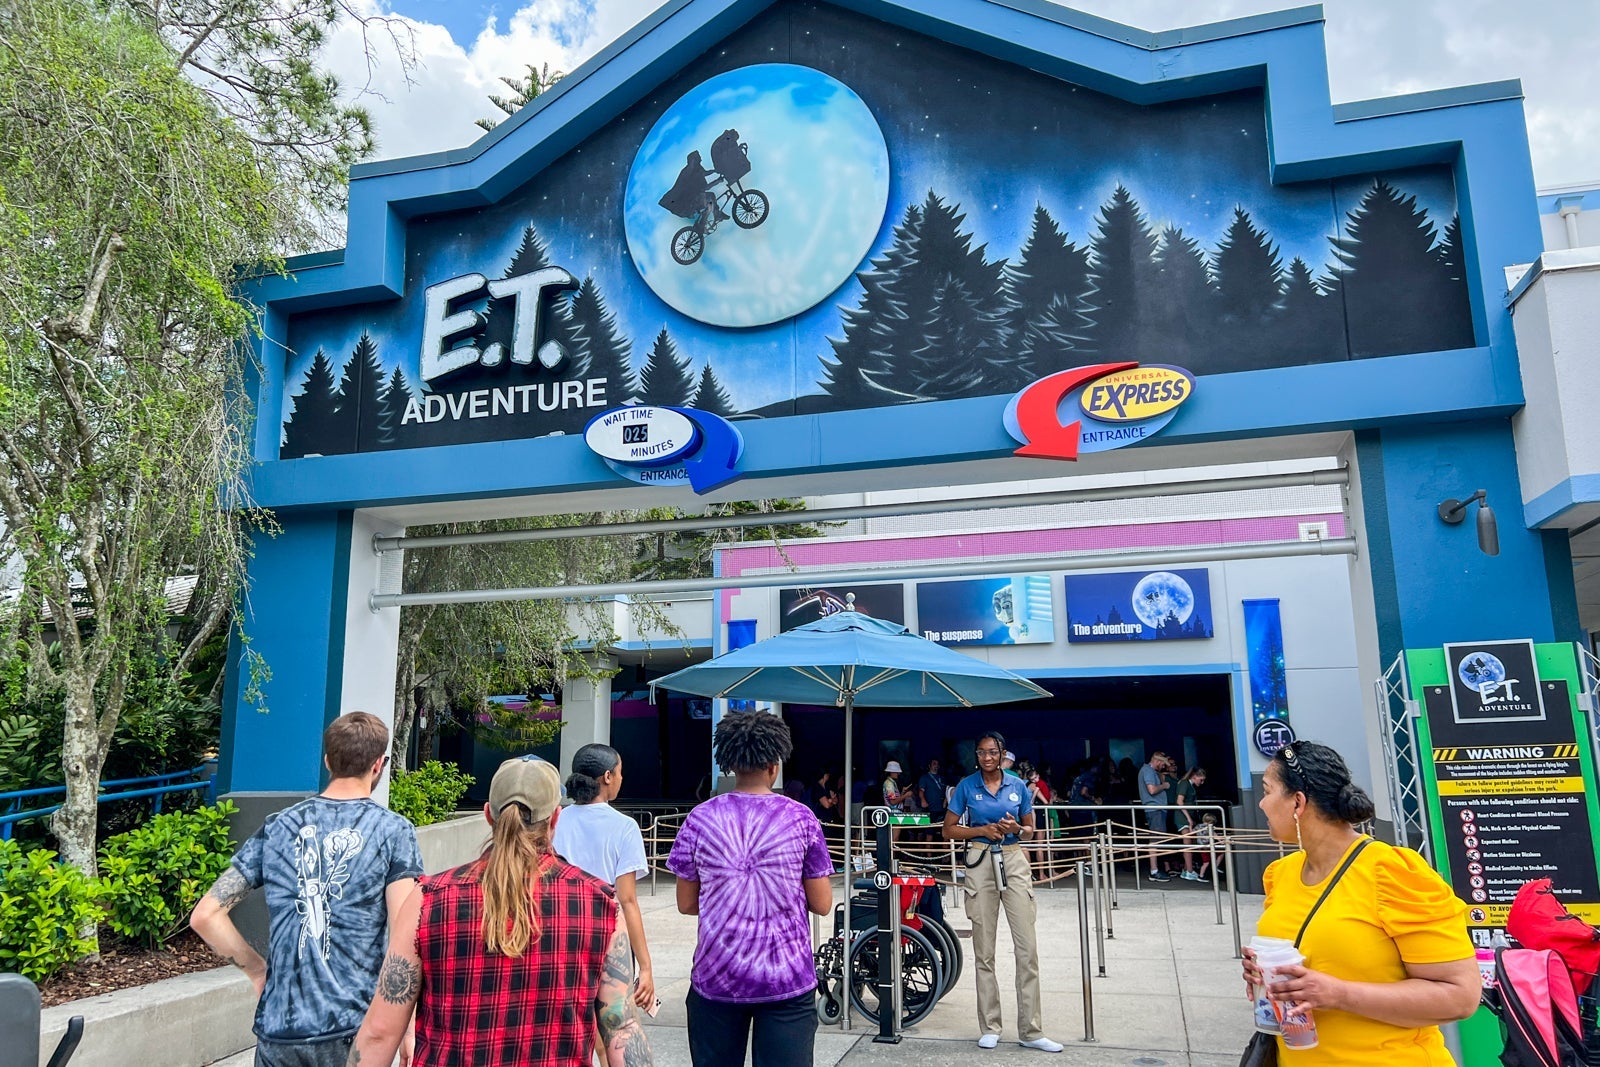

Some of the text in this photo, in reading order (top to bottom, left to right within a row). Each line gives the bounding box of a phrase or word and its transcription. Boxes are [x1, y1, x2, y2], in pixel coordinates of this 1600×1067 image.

[420, 266, 574, 381] E.T.
[1106, 371, 1169, 384] UNIVERSAL
[401, 377, 607, 425] ADVENTURE
[1089, 379, 1185, 417] EXPRESS
[604, 409, 653, 426] WAIT TIME
[623, 425, 649, 443] 025
[1082, 427, 1147, 444] ENTRANCE
[631, 440, 674, 457] MINUTES
[942, 629, 983, 643] suspense
[1073, 623, 1142, 636] The adventure
[1478, 679, 1521, 705] E.T.
[1478, 703, 1532, 712] ADVENTURE
[1260, 727, 1288, 744] E.T.
[1466, 746, 1544, 760] WARNING
